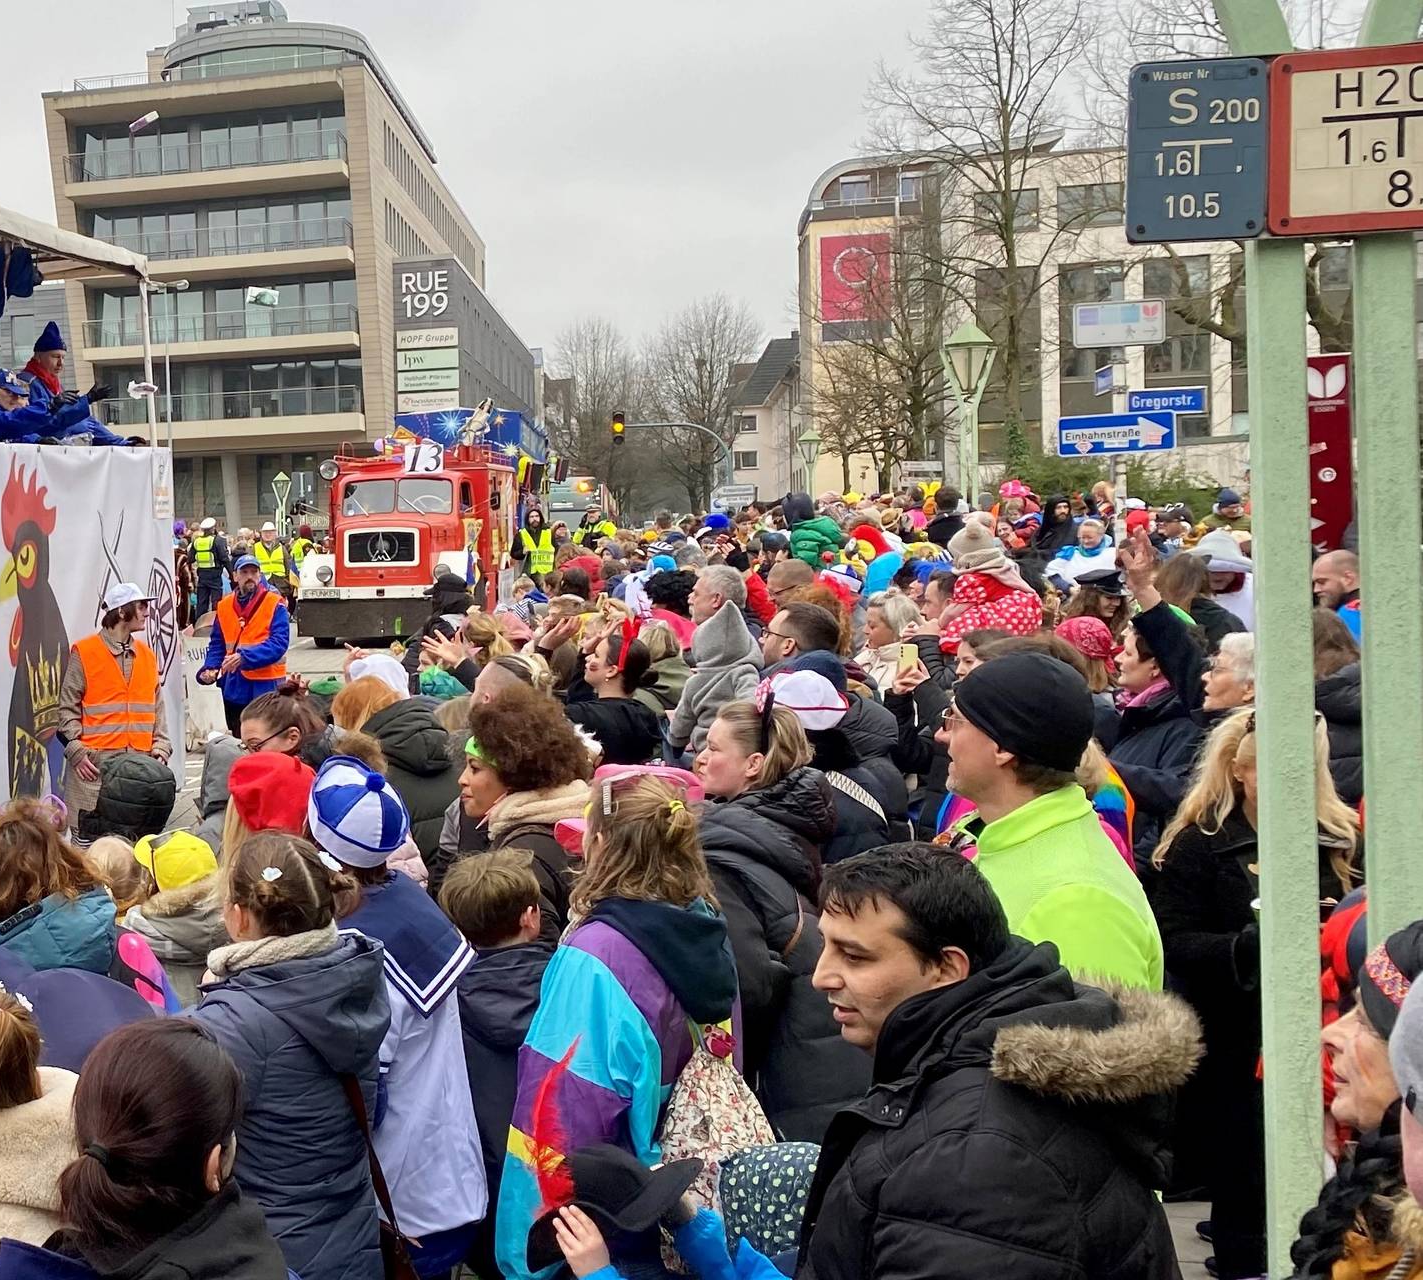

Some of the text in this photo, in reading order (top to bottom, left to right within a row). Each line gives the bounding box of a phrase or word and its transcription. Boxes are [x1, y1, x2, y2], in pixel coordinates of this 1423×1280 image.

[1152, 69, 1209, 82] Wasser Nr
[1168, 88, 1260, 125] S 200
[1165, 192, 1220, 219] 10,5
[401, 270, 448, 294] RUE
[402, 292, 449, 318] 199
[400, 334, 424, 344] HOPF
[1131, 394, 1195, 410] Gregorstr.
[1064, 428, 1141, 442] Einbahnstraße
[408, 444, 444, 472] 13
